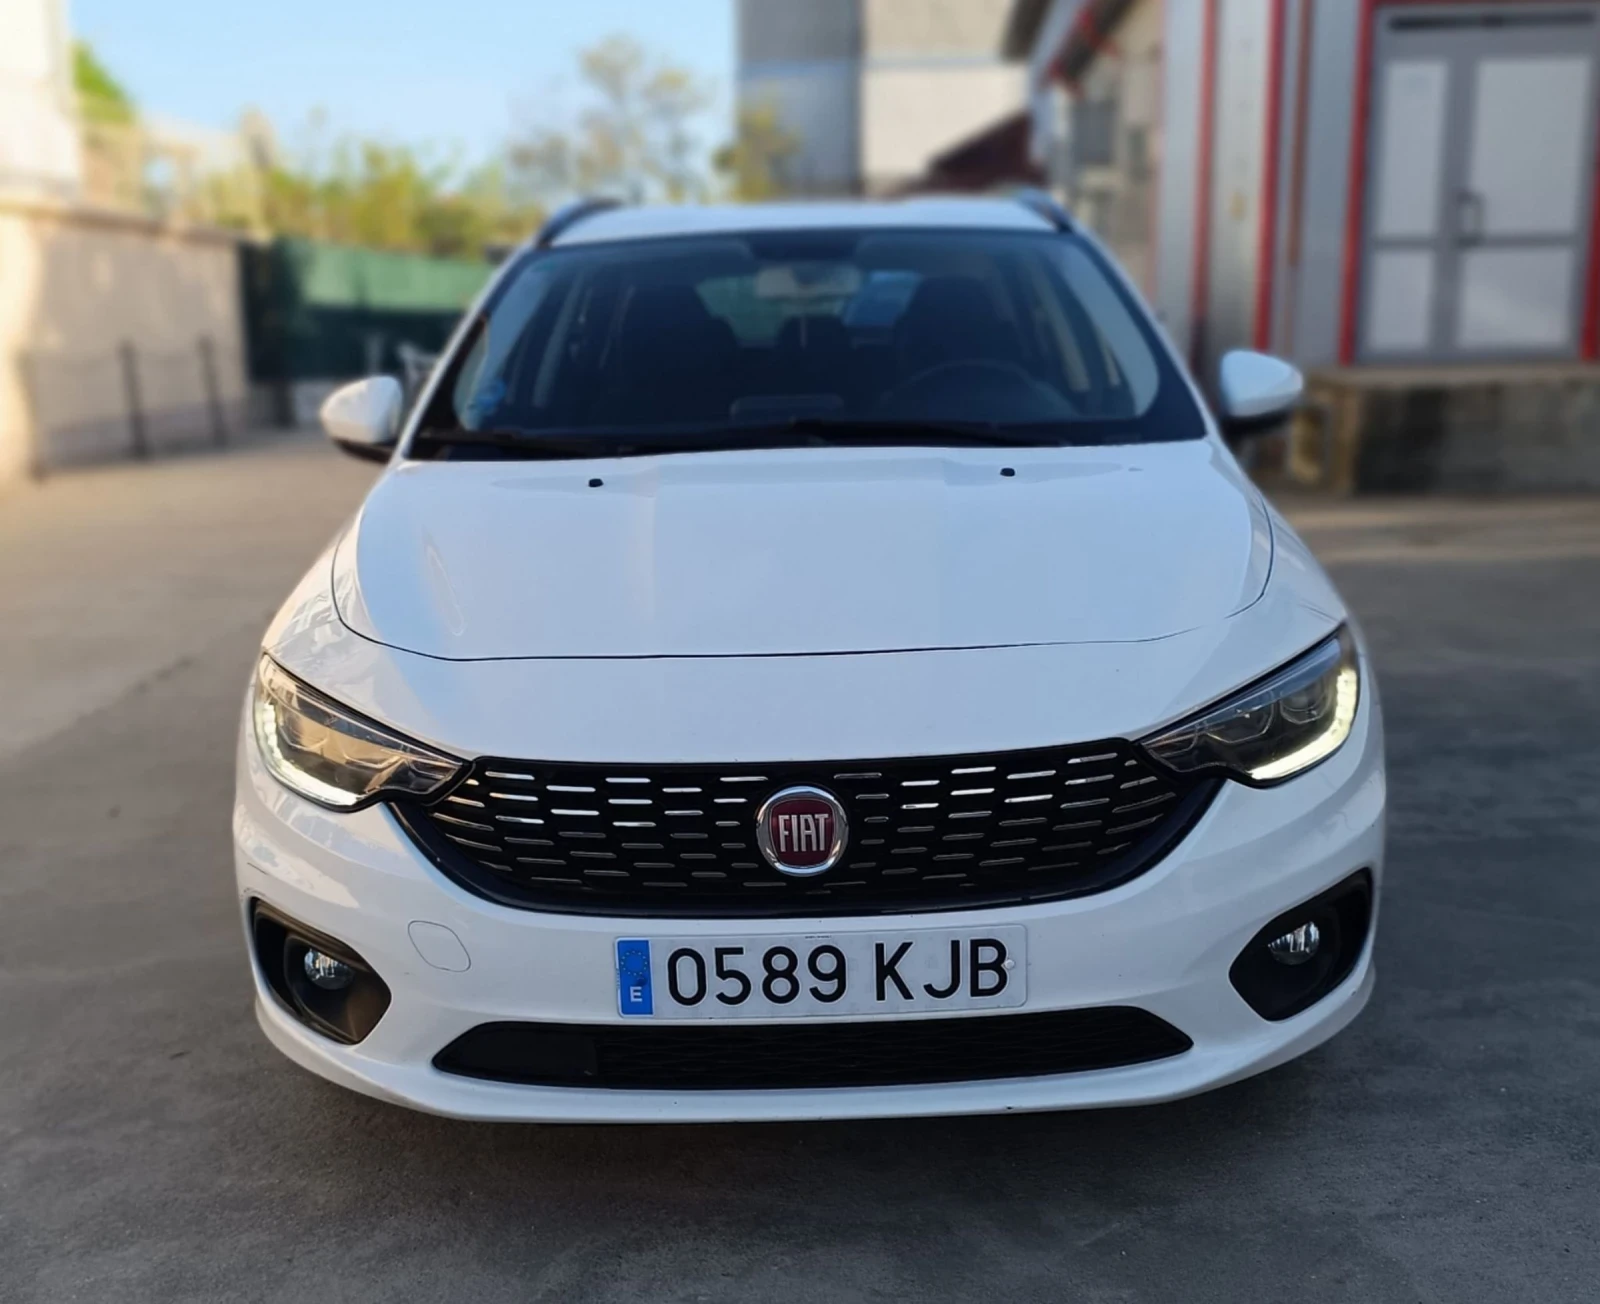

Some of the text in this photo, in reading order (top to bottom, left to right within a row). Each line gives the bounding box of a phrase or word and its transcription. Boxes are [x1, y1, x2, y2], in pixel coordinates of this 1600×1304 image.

[778, 814, 829, 852] FIAT
[667, 938, 1008, 1006] 0589 KJB
[630, 986, 643, 1003] E
